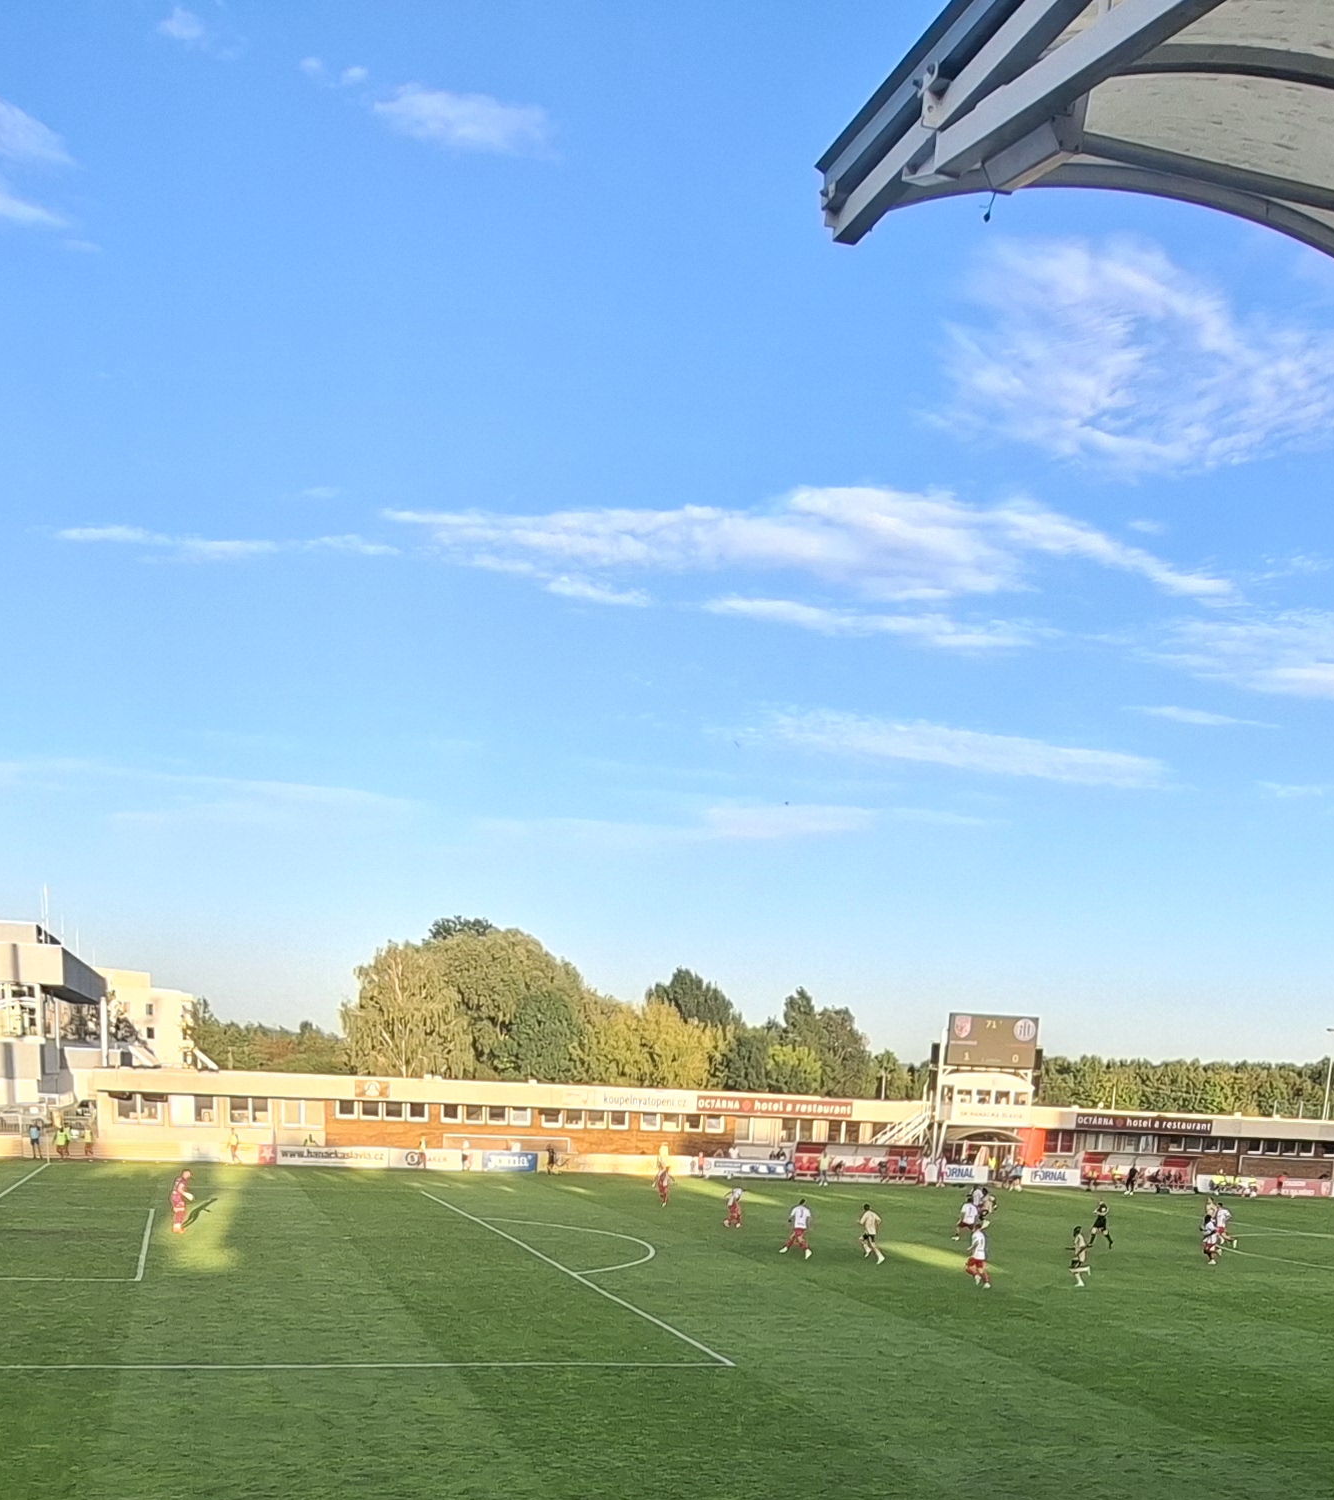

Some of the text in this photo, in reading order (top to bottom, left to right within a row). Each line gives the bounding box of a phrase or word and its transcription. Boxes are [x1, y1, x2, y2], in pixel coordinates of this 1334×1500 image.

[963, 1051, 970, 1061] 1
[1012, 1053, 1019, 1063] 0
[754, 1100, 784, 1112] hotel
[785, 1104, 793, 1112] a
[795, 1103, 852, 1115] restaurant
[1126, 1118, 1152, 1128] hotel
[1161, 1119, 1211, 1131] restaurant
[945, 1166, 975, 1178] ORNAL
